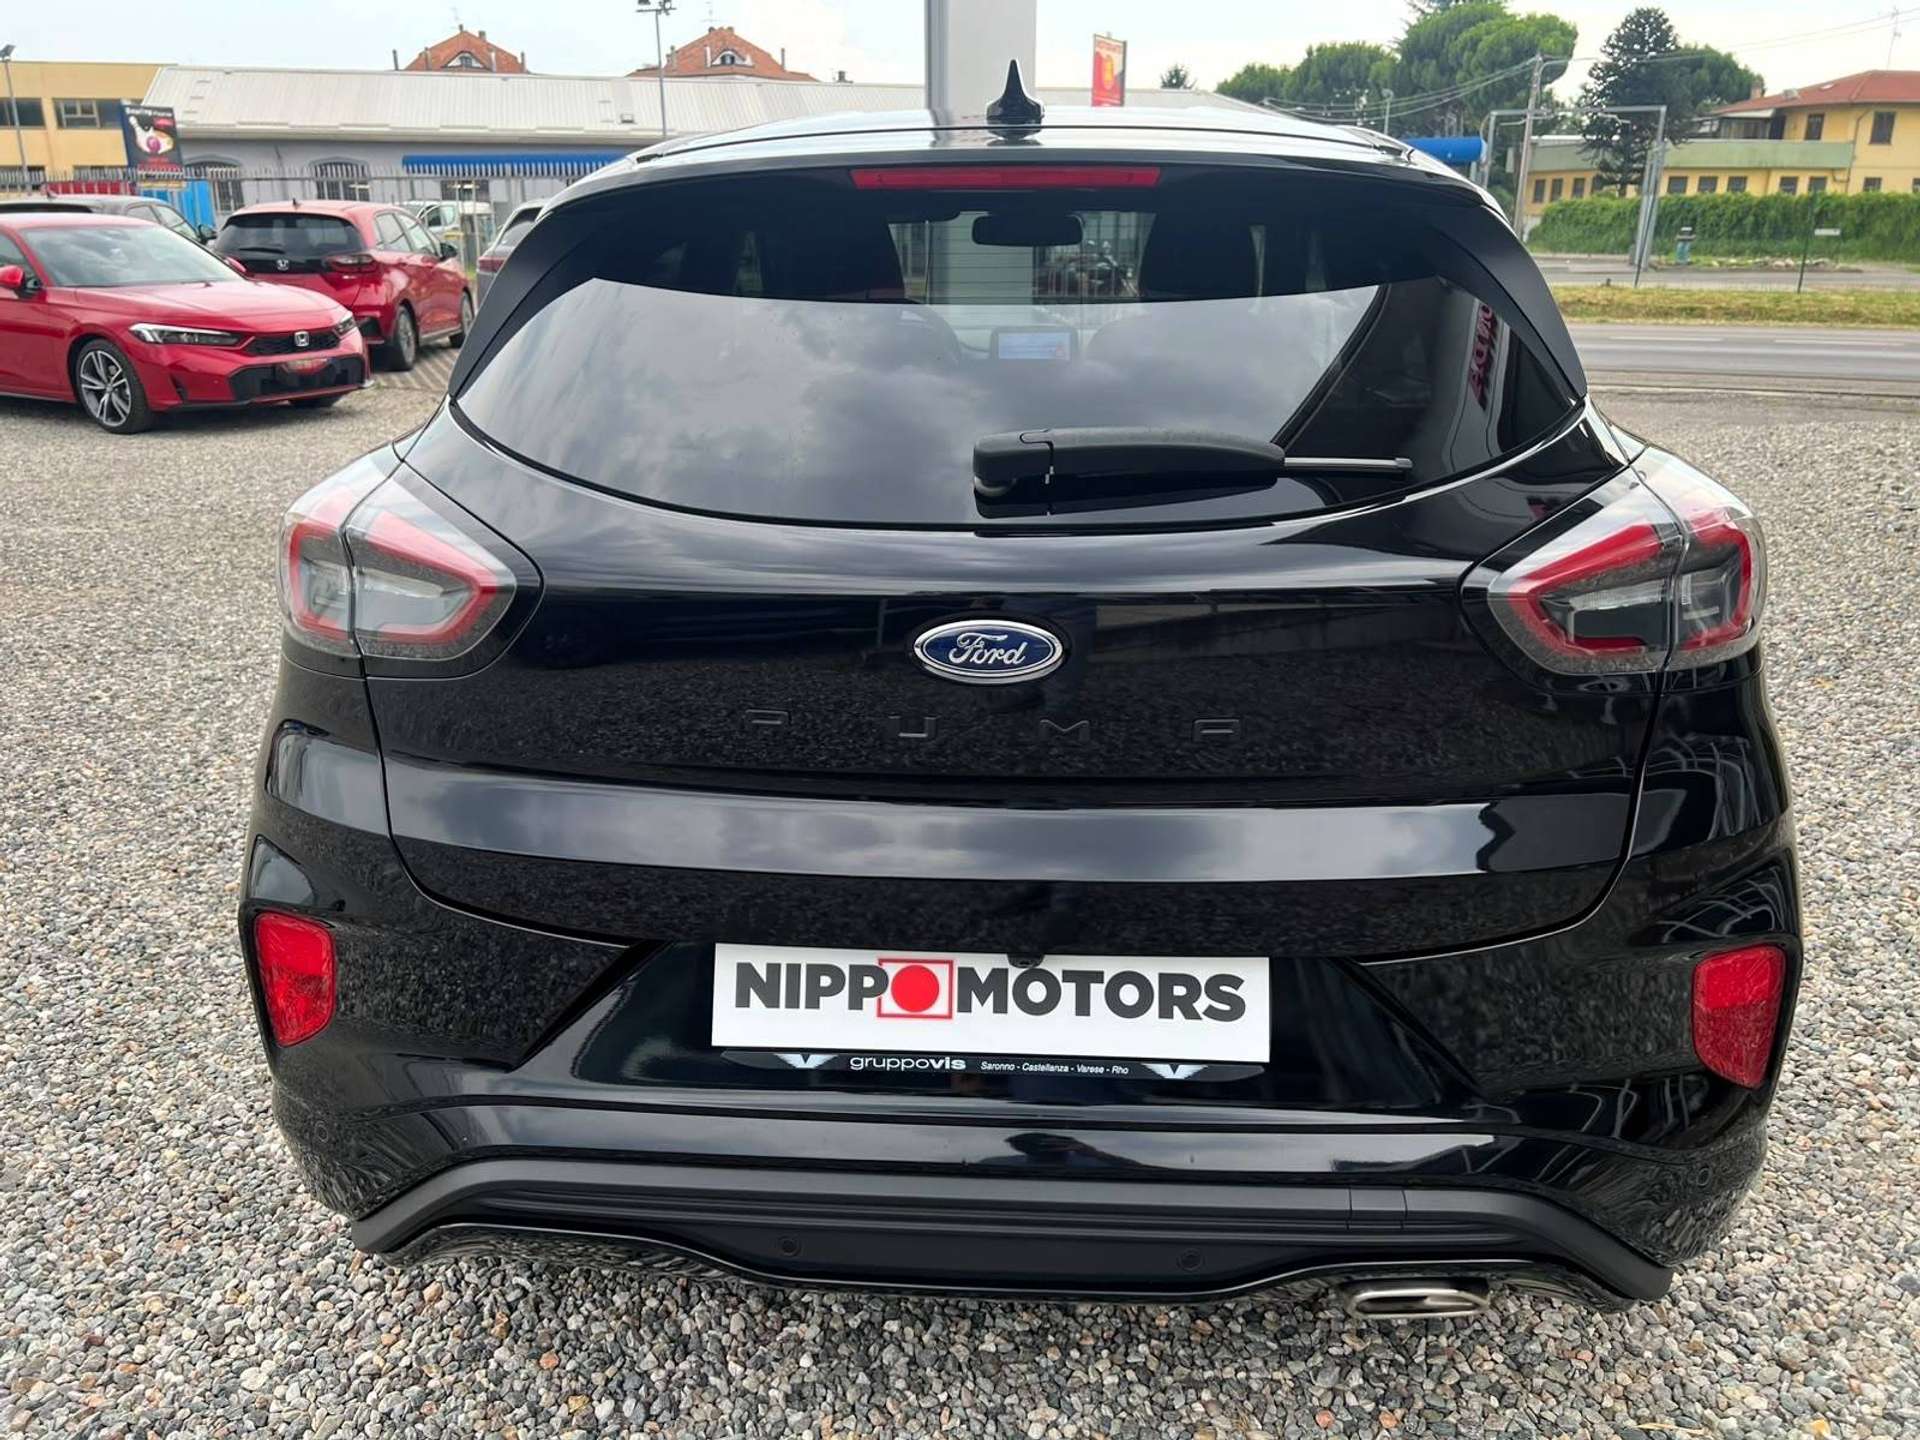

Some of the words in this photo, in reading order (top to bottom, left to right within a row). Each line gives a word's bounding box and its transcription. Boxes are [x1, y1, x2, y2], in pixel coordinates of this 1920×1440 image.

[949, 632, 1028, 664] Ford
[745, 709, 1240, 742] PUMA
[956, 966, 1246, 1023] MOTORS
[850, 1056, 966, 1071] gruppovis
[980, 1061, 1015, 1071] Saronno
[1022, 1062, 1069, 1073] Castellanza
[1076, 1064, 1104, 1074] Varese
[1112, 1065, 1129, 1075] Rho
